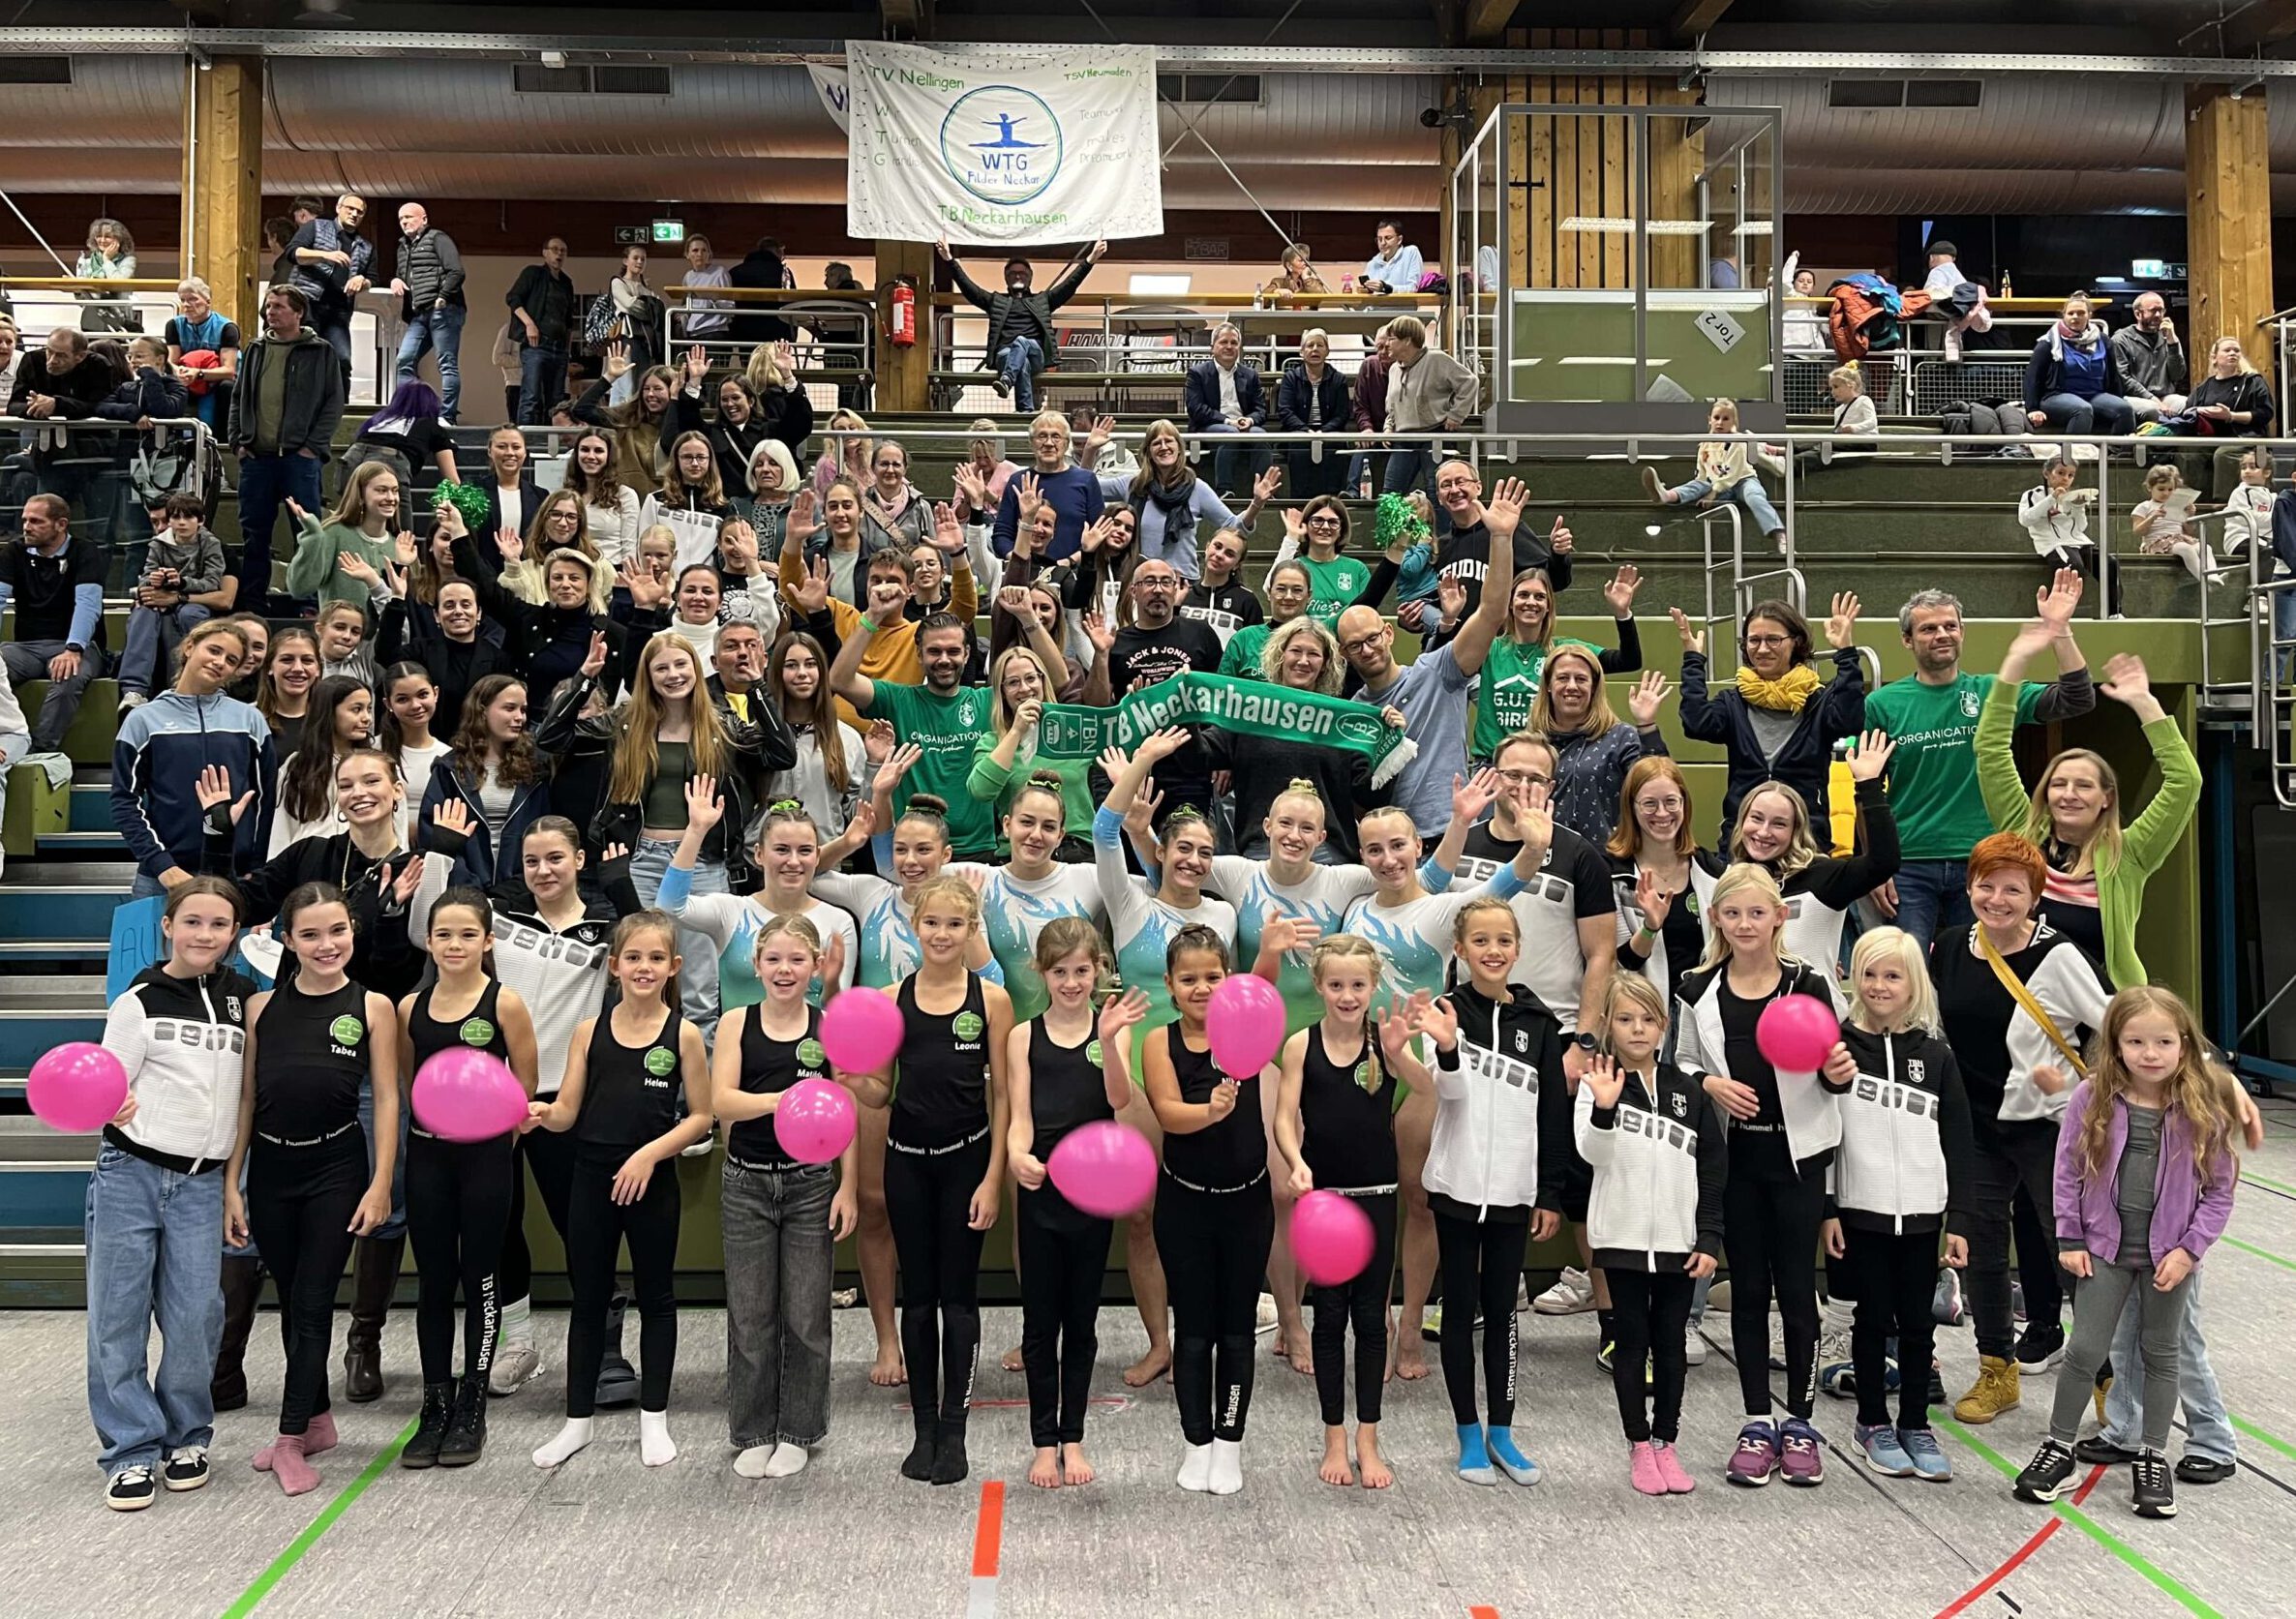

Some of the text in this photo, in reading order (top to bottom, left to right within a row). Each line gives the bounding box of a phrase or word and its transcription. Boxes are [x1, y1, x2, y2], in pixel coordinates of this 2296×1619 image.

[870, 65, 964, 92] TV Nellingen
[1064, 71, 1085, 80] TSV
[982, 153, 1027, 170] WTG
[968, 171, 1040, 185] Filder Neckar
[938, 204, 1067, 225] TB Neckarhausen
[1706, 313, 1734, 345] Tor 2
[1437, 558, 1489, 582] TUDIO
[1126, 648, 1150, 669] JACK
[1161, 646, 1192, 664] JONES
[1103, 680, 1334, 746] TB Neckarhausen
[911, 731, 982, 745] ORGANICATION
[1082, 715, 1098, 754] TBN
[1341, 719, 1379, 740] TBN
[1897, 725, 1979, 745] ORGANICATIO
[331, 1044, 356, 1057] Tabea
[645, 1077, 668, 1089] Helen
[1739, 1122, 1772, 1131] hummel
[895, 1141, 925, 1154] hummel
[930, 1139, 964, 1155] hummel
[482, 1273, 494, 1291] TB
